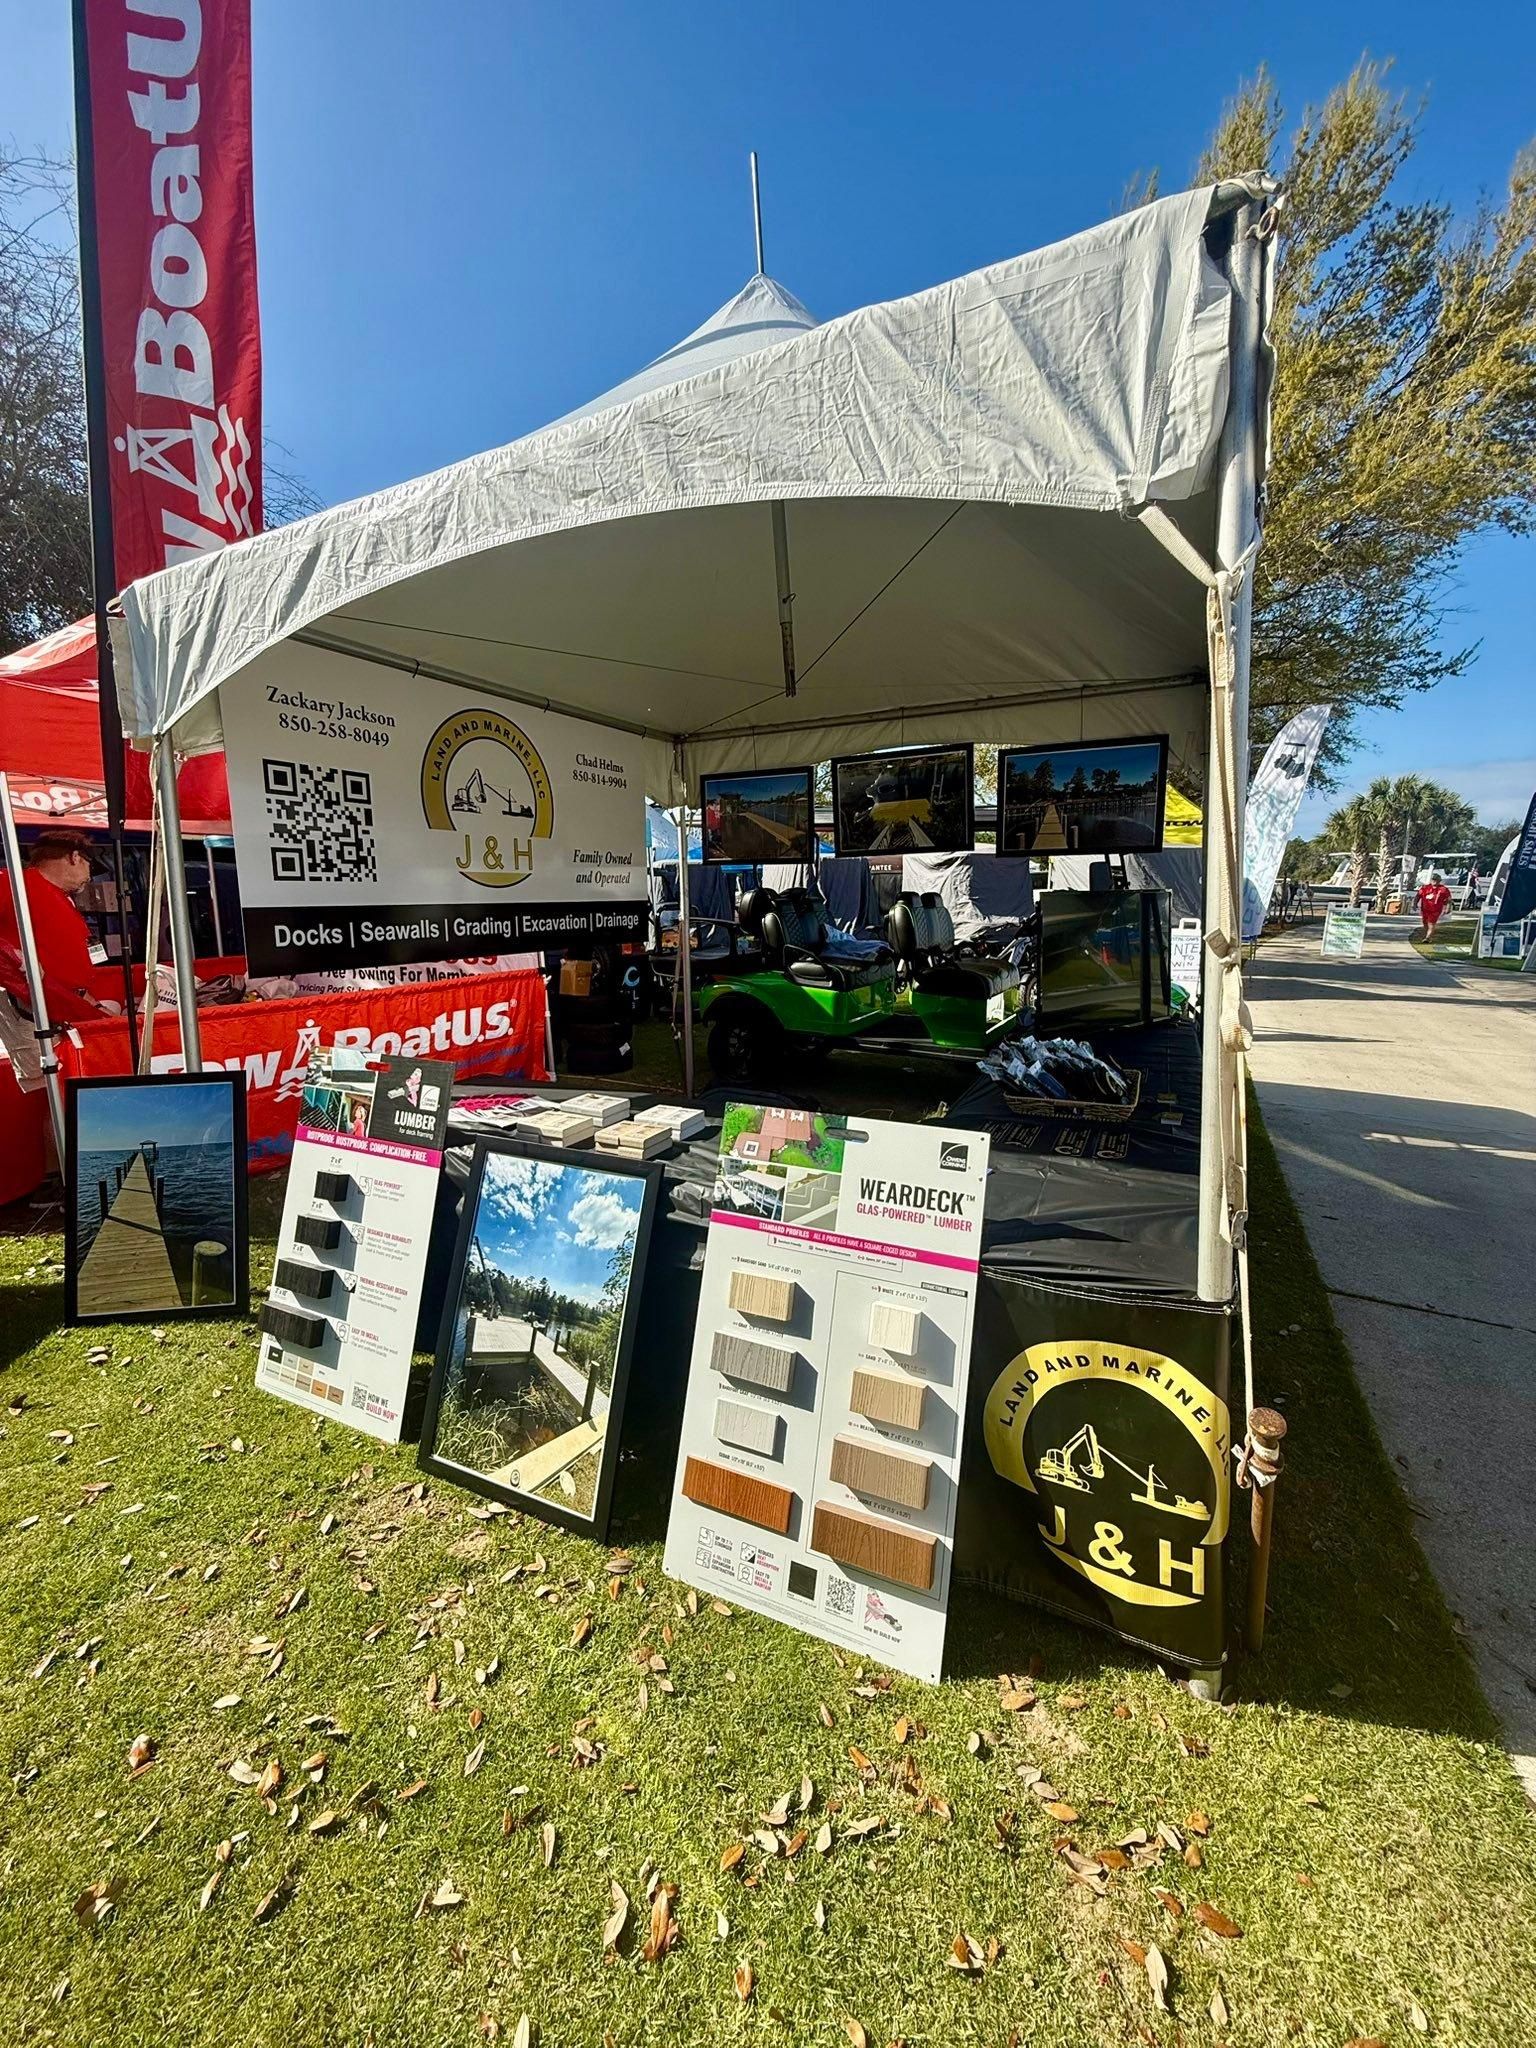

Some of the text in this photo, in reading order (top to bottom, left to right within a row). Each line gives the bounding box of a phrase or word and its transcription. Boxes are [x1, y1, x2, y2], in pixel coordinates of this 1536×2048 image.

[266, 685, 396, 727] Zackary Jackson
[279, 713, 389, 747] 850-258-8049
[431, 720, 545, 799] LAND AND MARINE, LLC
[576, 754, 624, 773] Chad Helms
[572, 770, 627, 789] 850-814-9904
[456, 834, 533, 870] J & H
[573, 849, 632, 867] Family Owned
[576, 870, 631, 887] and Operated
[274, 923, 343, 947] Docks
[360, 920, 440, 942] Seawalls
[453, 916, 511, 938] Grading
[522, 915, 587, 932] Excavation
[596, 913, 639, 930] Drainage
[400, 967, 422, 982] For
[394, 1110, 436, 1131] LUMBER
[416, 1130, 434, 1141] framing
[934, 1215, 972, 1232] LUMBER
[759, 1222, 785, 1233] STANDARD
[786, 1227, 809, 1239] PROFILES
[813, 1232, 821, 1240] ALL
[826, 1235, 847, 1245] PROFILES
[847, 1239, 859, 1247] HAVE
[899, 1248, 917, 1259] DESIGN
[368, 1392, 389, 1408] HOW WE
[1000, 1369, 1039, 1427] LAND
[1044, 1355, 1090, 1374] AND
[1102, 1355, 1211, 1433] MARINE,
[366, 1403, 382, 1415] BUILD
[1037, 1505, 1205, 1595] J & H
